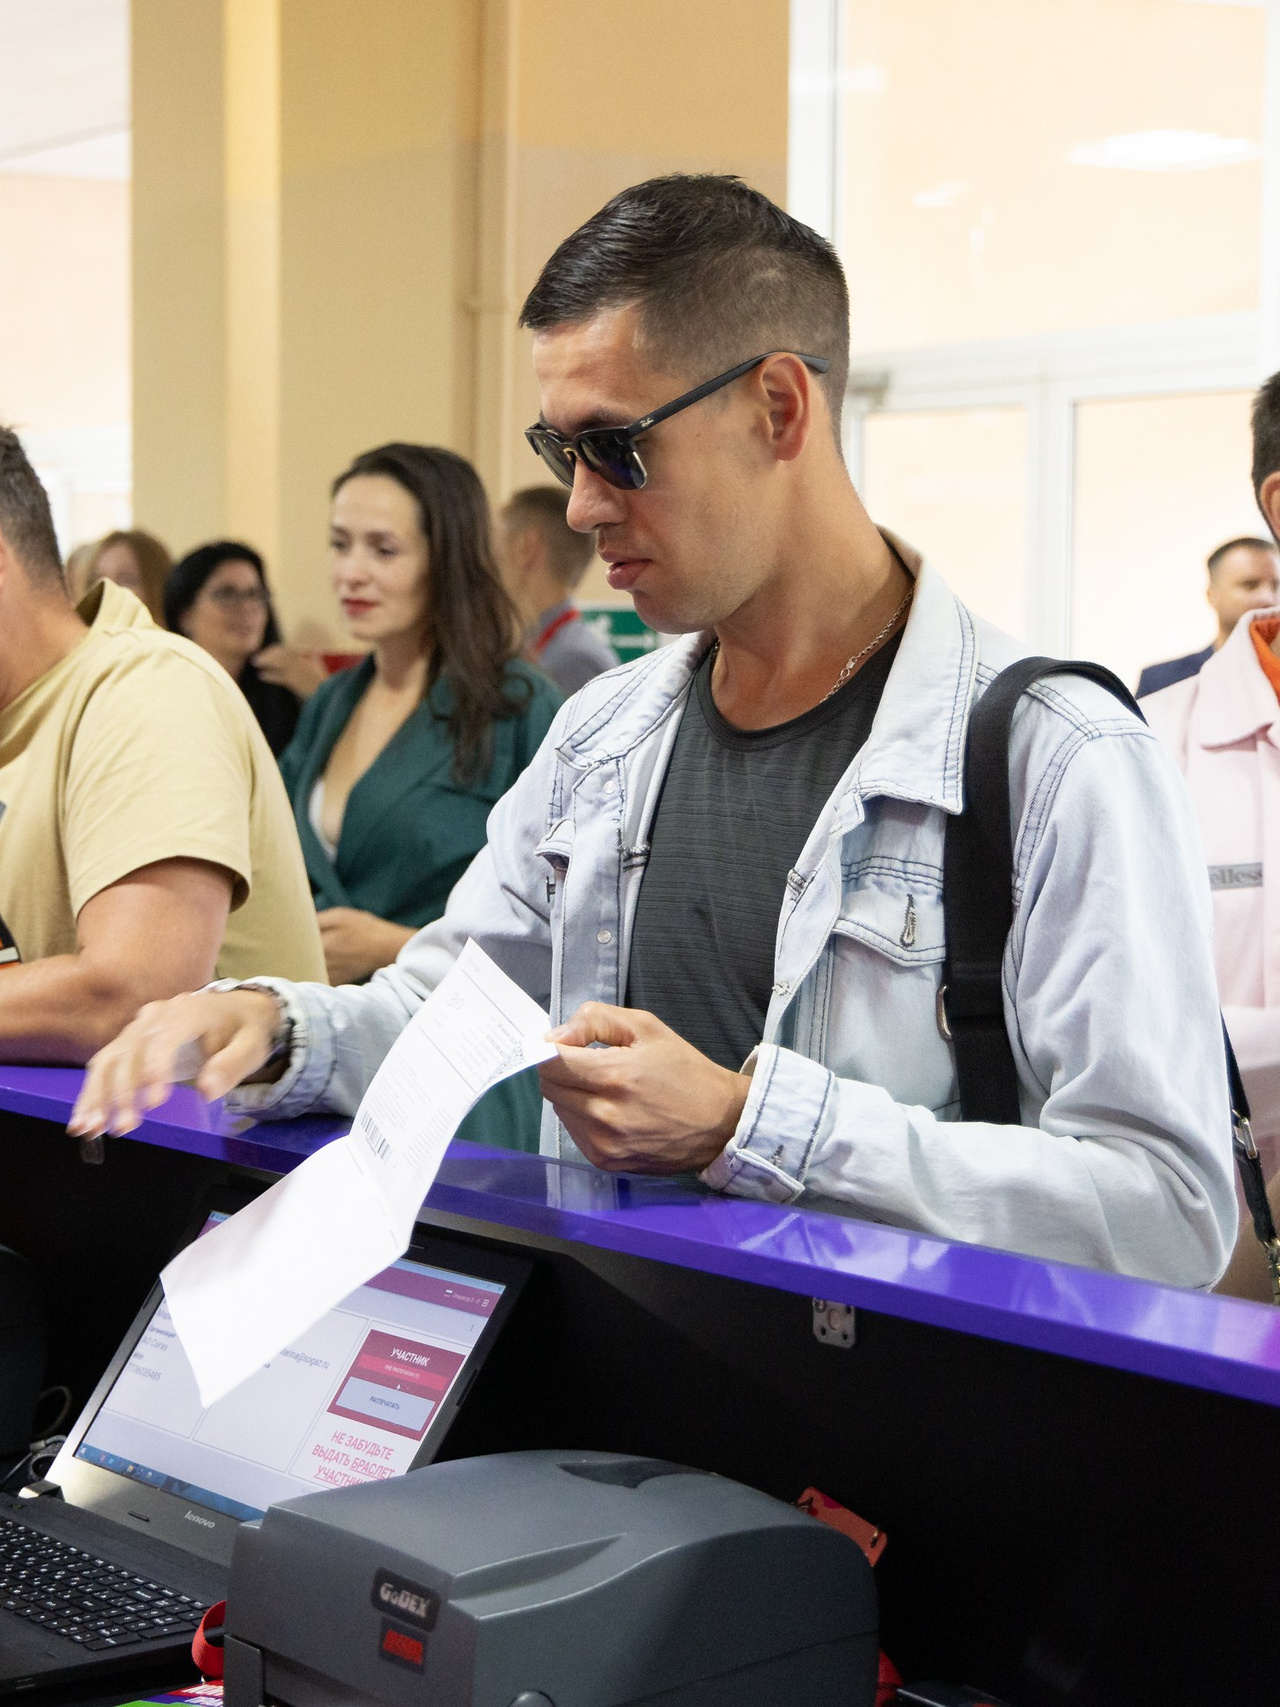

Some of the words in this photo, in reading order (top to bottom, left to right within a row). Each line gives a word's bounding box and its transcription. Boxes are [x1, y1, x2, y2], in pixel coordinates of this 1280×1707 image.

[390, 1347, 430, 1367] УЧАСТНИК
[331, 1430, 347, 1444] НЕ
[345, 1435, 394, 1460] ЗАБУДЬТЕ
[312, 1444, 350, 1466] ВЫДАТЬ
[350, 1457, 395, 1479] БРАСЛЕТ
[184, 1510, 215, 1528] lenovo
